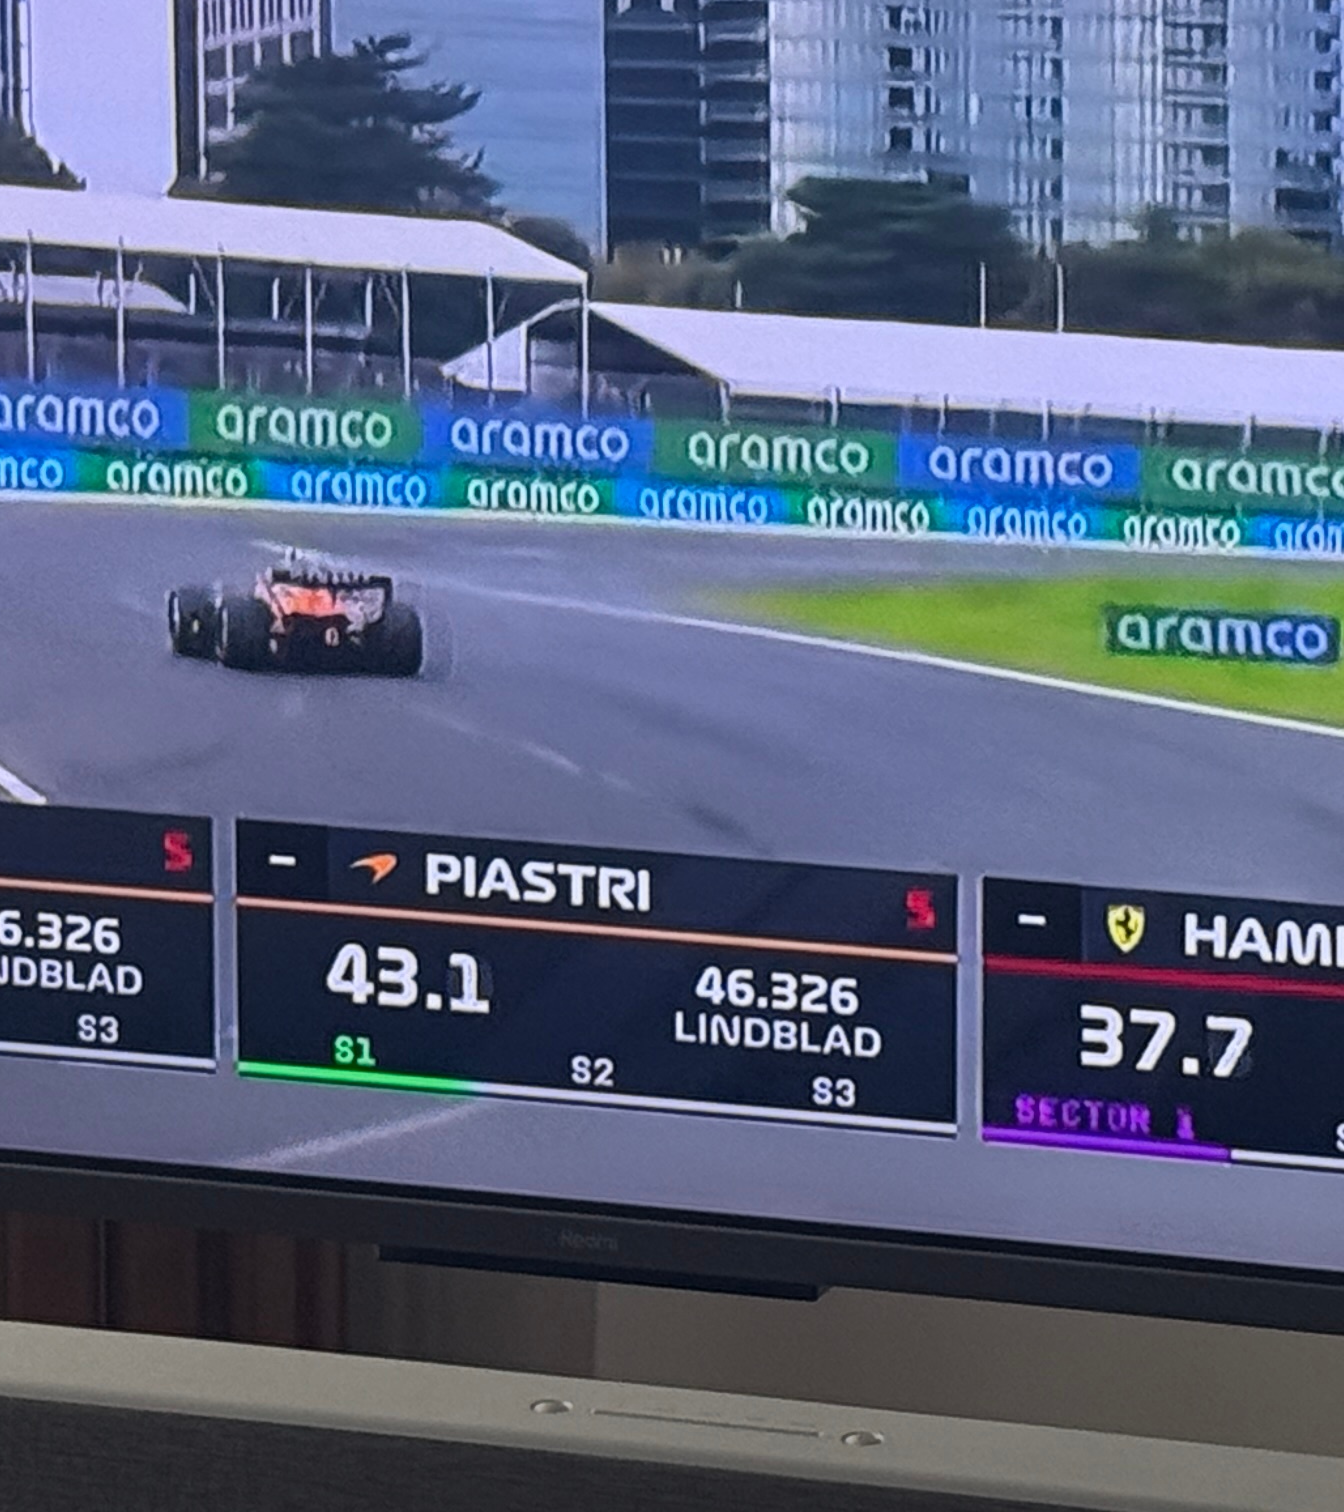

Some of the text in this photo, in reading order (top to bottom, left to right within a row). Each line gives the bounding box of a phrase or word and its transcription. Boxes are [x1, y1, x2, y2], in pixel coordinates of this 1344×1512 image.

[216, 401, 392, 449] aramco
[451, 416, 629, 463] aramco
[688, 427, 869, 476] aramco
[929, 443, 1113, 489] aramco
[106, 456, 248, 498] aramco
[291, 467, 427, 507] aramco
[467, 473, 599, 514] aramco
[639, 484, 769, 525] aramco
[808, 493, 930, 534] aramco
[967, 505, 1087, 543] aramco
[1122, 512, 1241, 549] aramco
[1118, 608, 1328, 659] aramco
[162, 829, 193, 871] S
[425, 852, 650, 912] PIASTRI
[326, 942, 860, 1015] 43.1 46.326
[77, 1014, 119, 1043] S3
[674, 1011, 881, 1059] LINDBLAD
[1080, 1004, 1253, 1077] 37.7
[334, 1036, 856, 1108] S1 S2 S3
[1015, 1093, 1151, 1135] SECTOR
